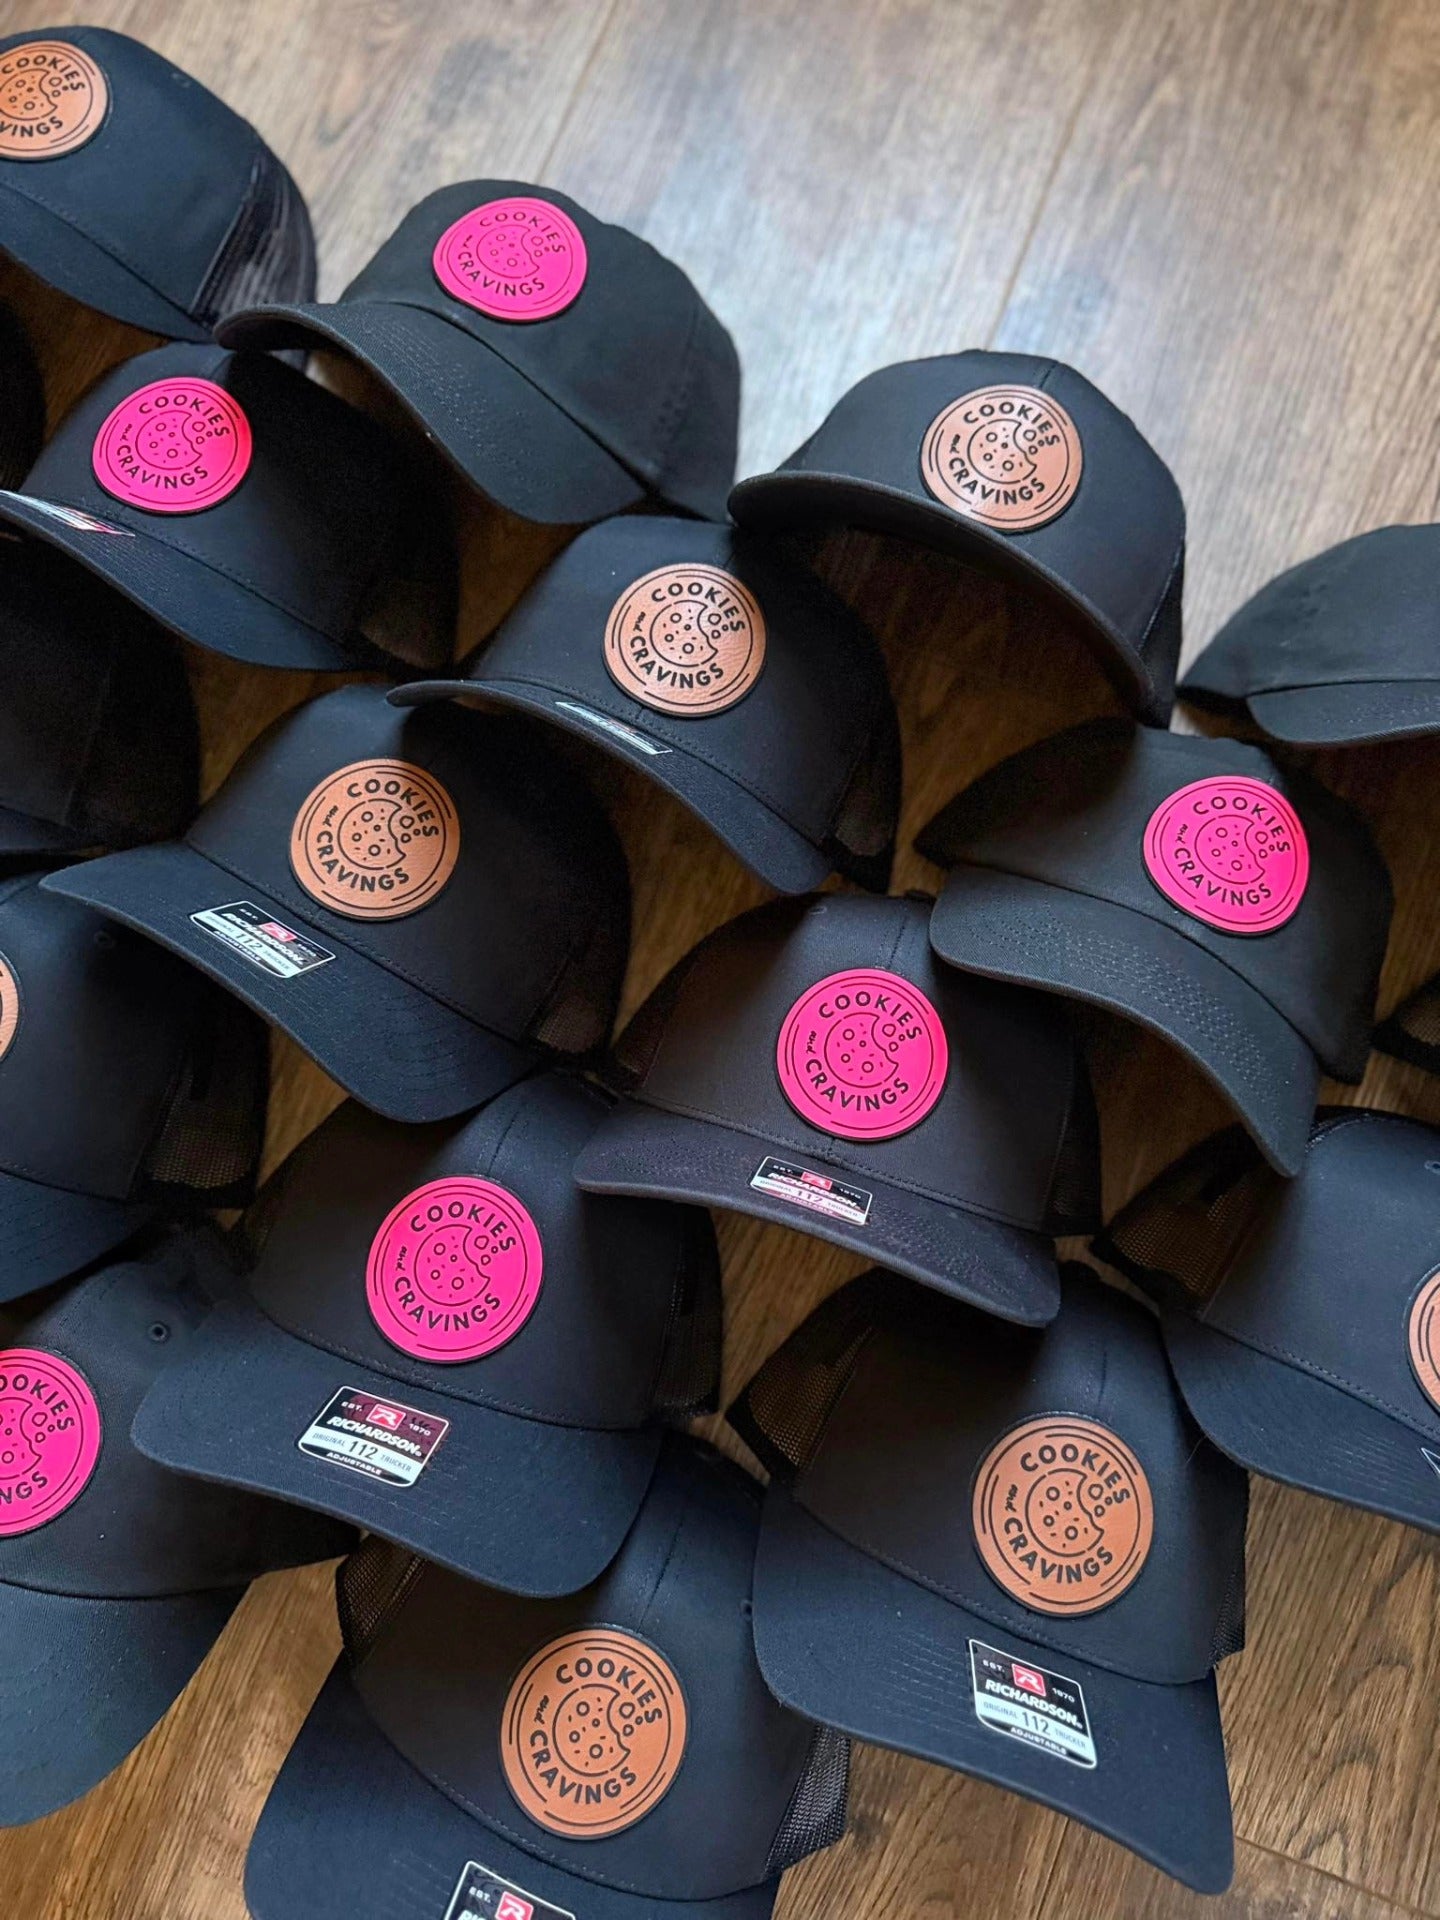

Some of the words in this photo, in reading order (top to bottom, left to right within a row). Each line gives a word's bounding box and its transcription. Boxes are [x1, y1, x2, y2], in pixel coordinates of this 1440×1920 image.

[2, 55, 85, 91] COOKIES
[479, 212, 566, 253] COOKIES
[458, 251, 545, 296] CRAVINGS
[138, 394, 230, 437] COOKIES
[963, 401, 1060, 446] COOKIES
[116, 444, 208, 489] CRAVINGS
[948, 456, 1045, 505] CRAVINGS
[651, 582, 746, 632] COOKIES
[630, 635, 724, 689] CRAVINGS
[322, 804, 339, 827] and
[347, 778, 439, 837] COOKIES
[1193, 796, 1291, 852] COOKIES
[316, 830, 410, 892] CRAVINGS
[1174, 848, 1272, 906] CRAVINGS
[236, 932, 263, 950] 112
[818, 991, 923, 1040] COOKIES
[806, 1030, 817, 1054] and
[805, 1058, 909, 1112] CRAVINGS
[798, 1190, 824, 1202] 112
[410, 1201, 516, 1251] COOKIES
[394, 1276, 501, 1332] CRAVINGS
[341, 1401, 363, 1412] EST.
[408, 1423, 431, 1437] 1970
[311, 1432, 346, 1446] ORIGINAL
[348, 1440, 379, 1460] 112
[380, 1454, 412, 1472] TRUCKER
[326, 1451, 382, 1475] ADJUSTABLE
[1020, 1443, 1131, 1504] COOKIES
[1004, 1483, 1019, 1513] and
[1004, 1517, 1114, 1584] CRAVINGS
[533, 1694, 550, 1725] and
[555, 1657, 663, 1724] COOKIES
[983, 1701, 1018, 1719] ORIGINAL
[1022, 1711, 1051, 1735] 112
[1055, 1728, 1086, 1748] TRUCKER
[1010, 1727, 1067, 1755] ADJUSTABLE
[530, 1729, 637, 1805] CRAVINGS
